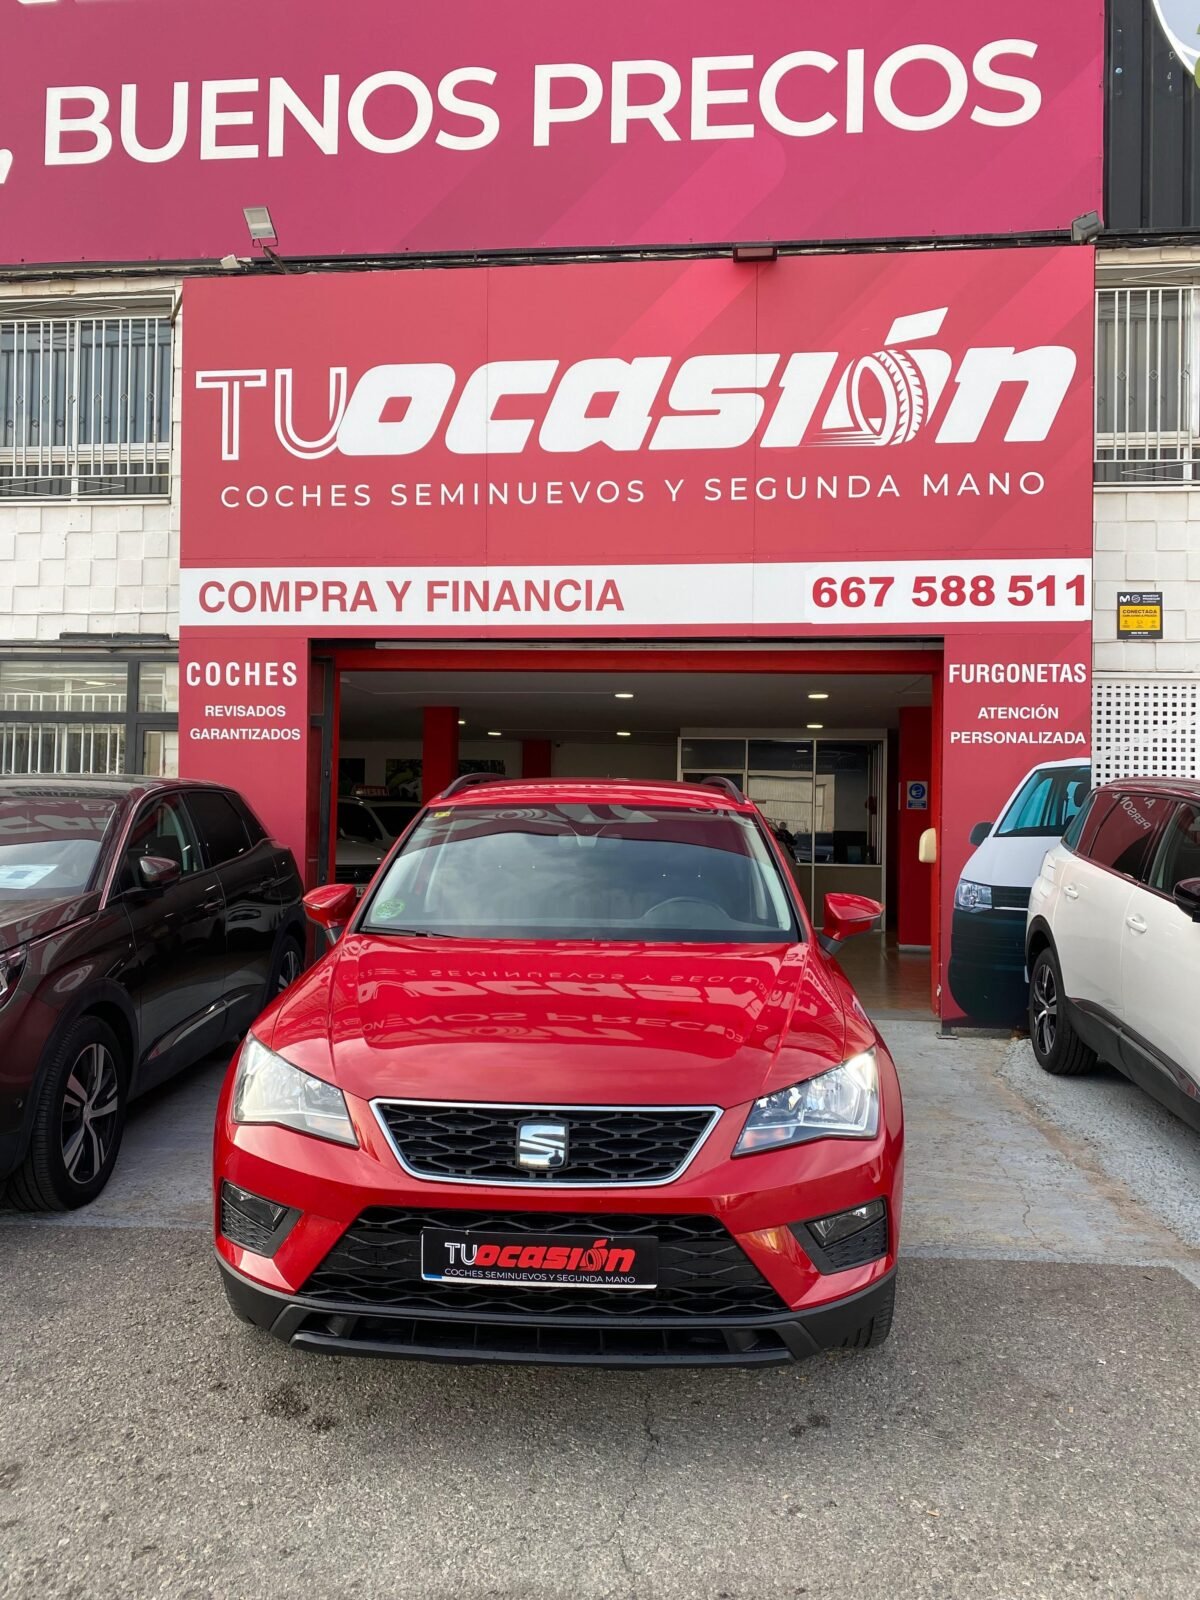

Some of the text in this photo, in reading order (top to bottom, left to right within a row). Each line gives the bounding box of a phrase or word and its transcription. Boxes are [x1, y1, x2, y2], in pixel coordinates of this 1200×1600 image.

[44, 38, 1042, 166] BUENOS PRECIOS
[220, 471, 1046, 508] COCHES SEMINUEVOS Y SEGUNDA MANO
[199, 579, 625, 613] COMPRA Y FINANCIA
[812, 574, 1085, 608] 667 588 511
[186, 661, 298, 687] COCHES
[948, 663, 1087, 684] FURGONETAS
[204, 705, 286, 718] REVISADOS
[977, 703, 1059, 720] ATENCIÓN
[189, 728, 301, 741] GARANTIZADOS
[950, 731, 1087, 744] PERSONALIZADA
[444, 1268, 484, 1278] COCHES
[485, 1271, 547, 1281] SEMINUEVOS
[556, 1274, 604, 1282] SEGUNDA
[605, 1276, 636, 1284] MANO
